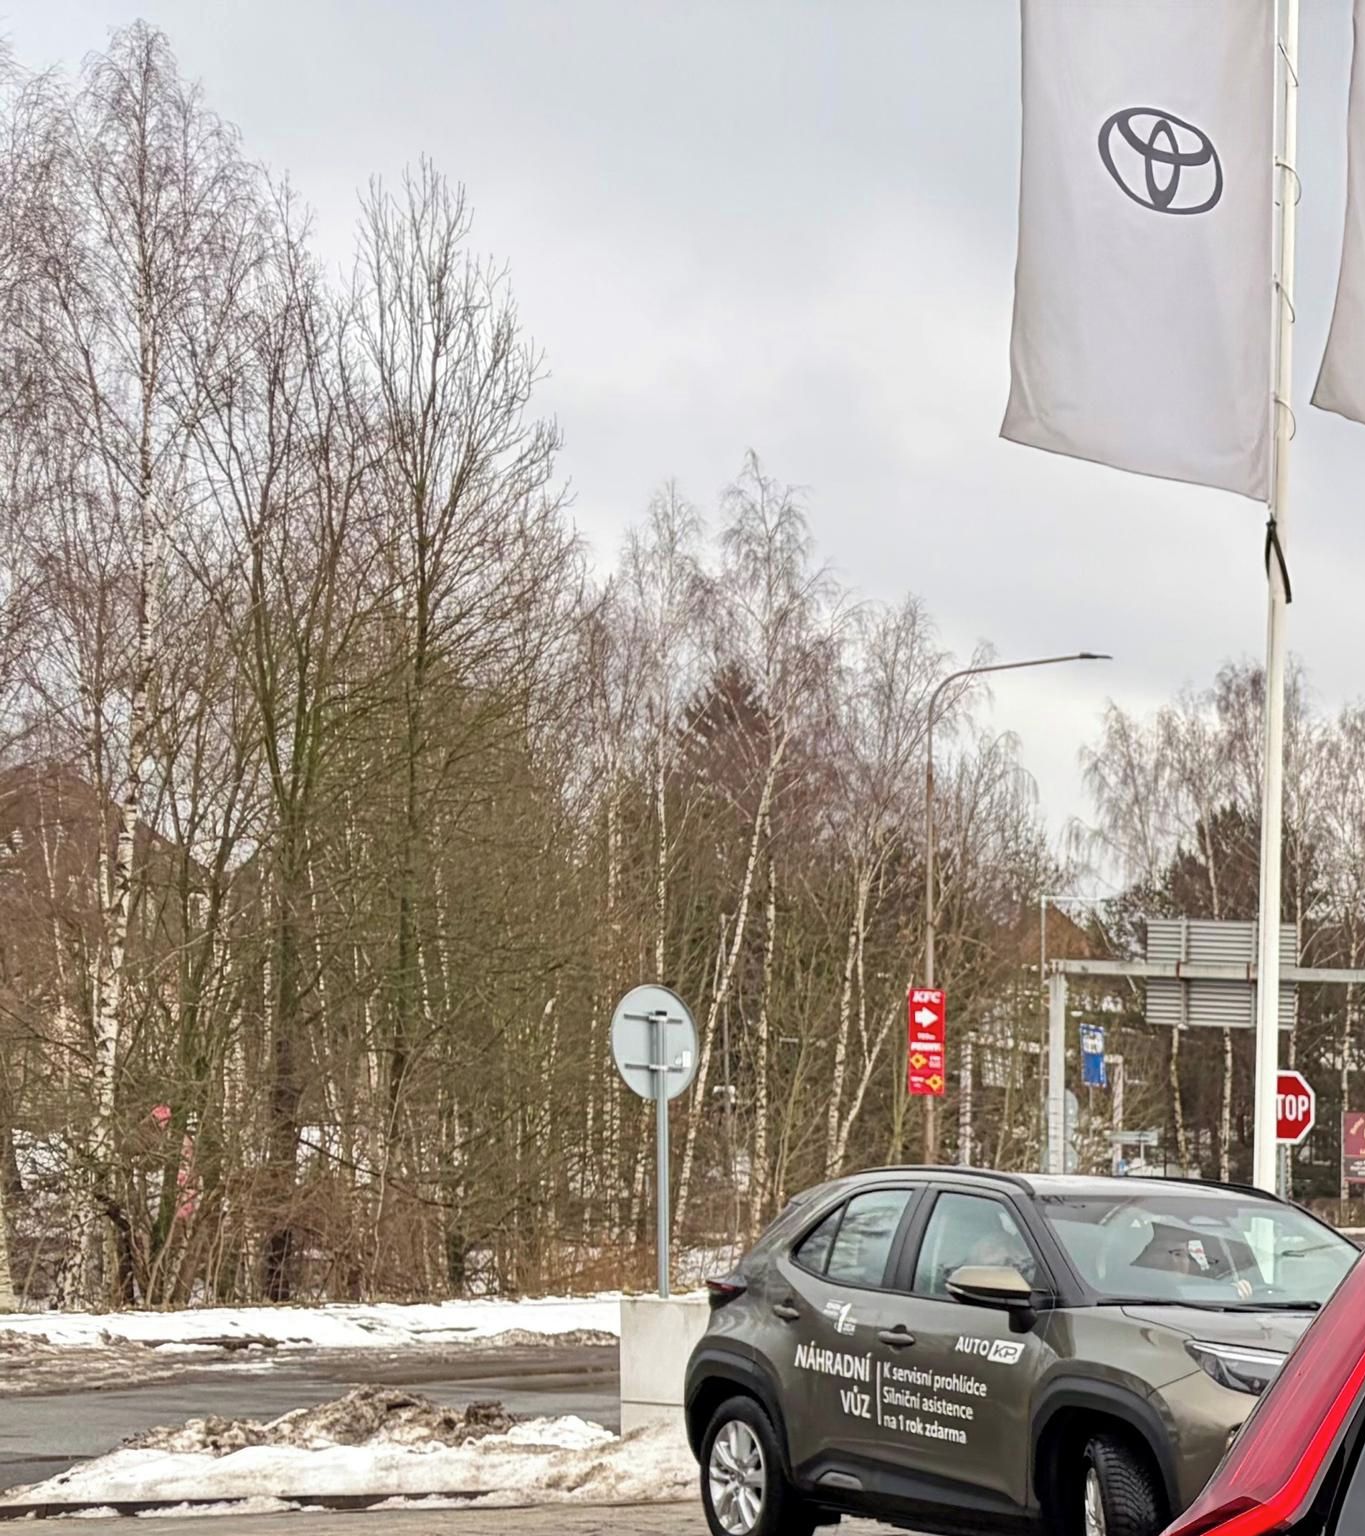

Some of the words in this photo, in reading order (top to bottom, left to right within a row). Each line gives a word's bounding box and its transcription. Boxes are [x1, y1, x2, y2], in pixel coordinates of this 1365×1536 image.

[912, 990, 941, 1004] KFC
[1277, 1094, 1309, 1122] TOP
[794, 1341, 872, 1382] NÁHRADNÍ
[955, 1336, 989, 1357] AUTO
[883, 1363, 892, 1378] K
[893, 1366, 932, 1387] servisní
[933, 1373, 987, 1397] prohlídce
[840, 1387, 871, 1419] VŮZ
[883, 1386, 920, 1410] Silniční
[922, 1396, 973, 1420] asistence
[884, 1414, 897, 1429] na
[905, 1416, 923, 1435] rok
[924, 1421, 967, 1445] zdarma
